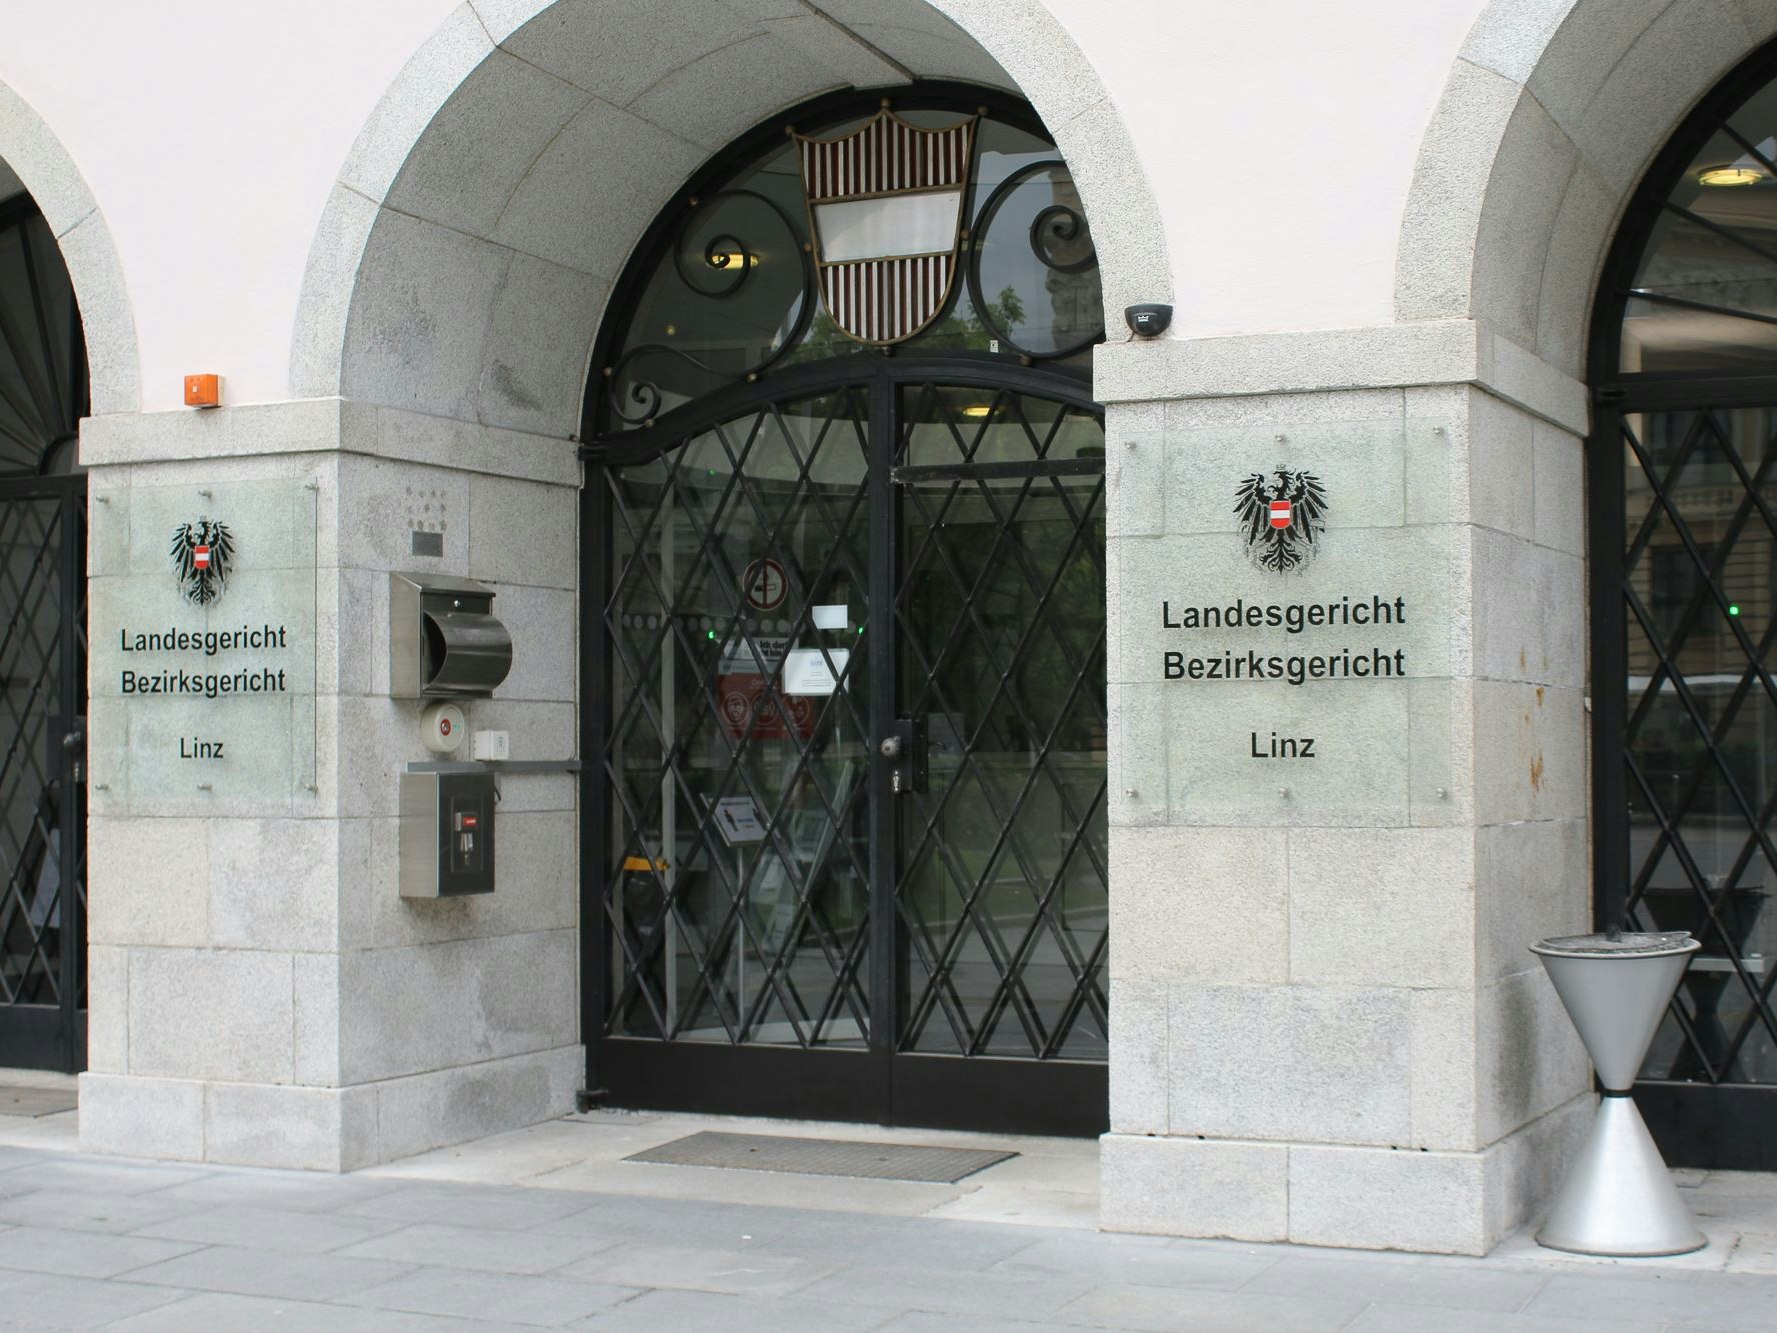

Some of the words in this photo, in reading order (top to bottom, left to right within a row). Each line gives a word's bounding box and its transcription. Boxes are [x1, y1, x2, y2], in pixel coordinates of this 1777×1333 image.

[1162, 595, 1406, 634] Landesgericht
[121, 624, 286, 657] Landesgericht
[1164, 647, 1406, 686] Bezirksgericht
[122, 668, 286, 699] Bezirksgericht
[180, 737, 224, 759] Linz
[1251, 731, 1315, 758] Linz
